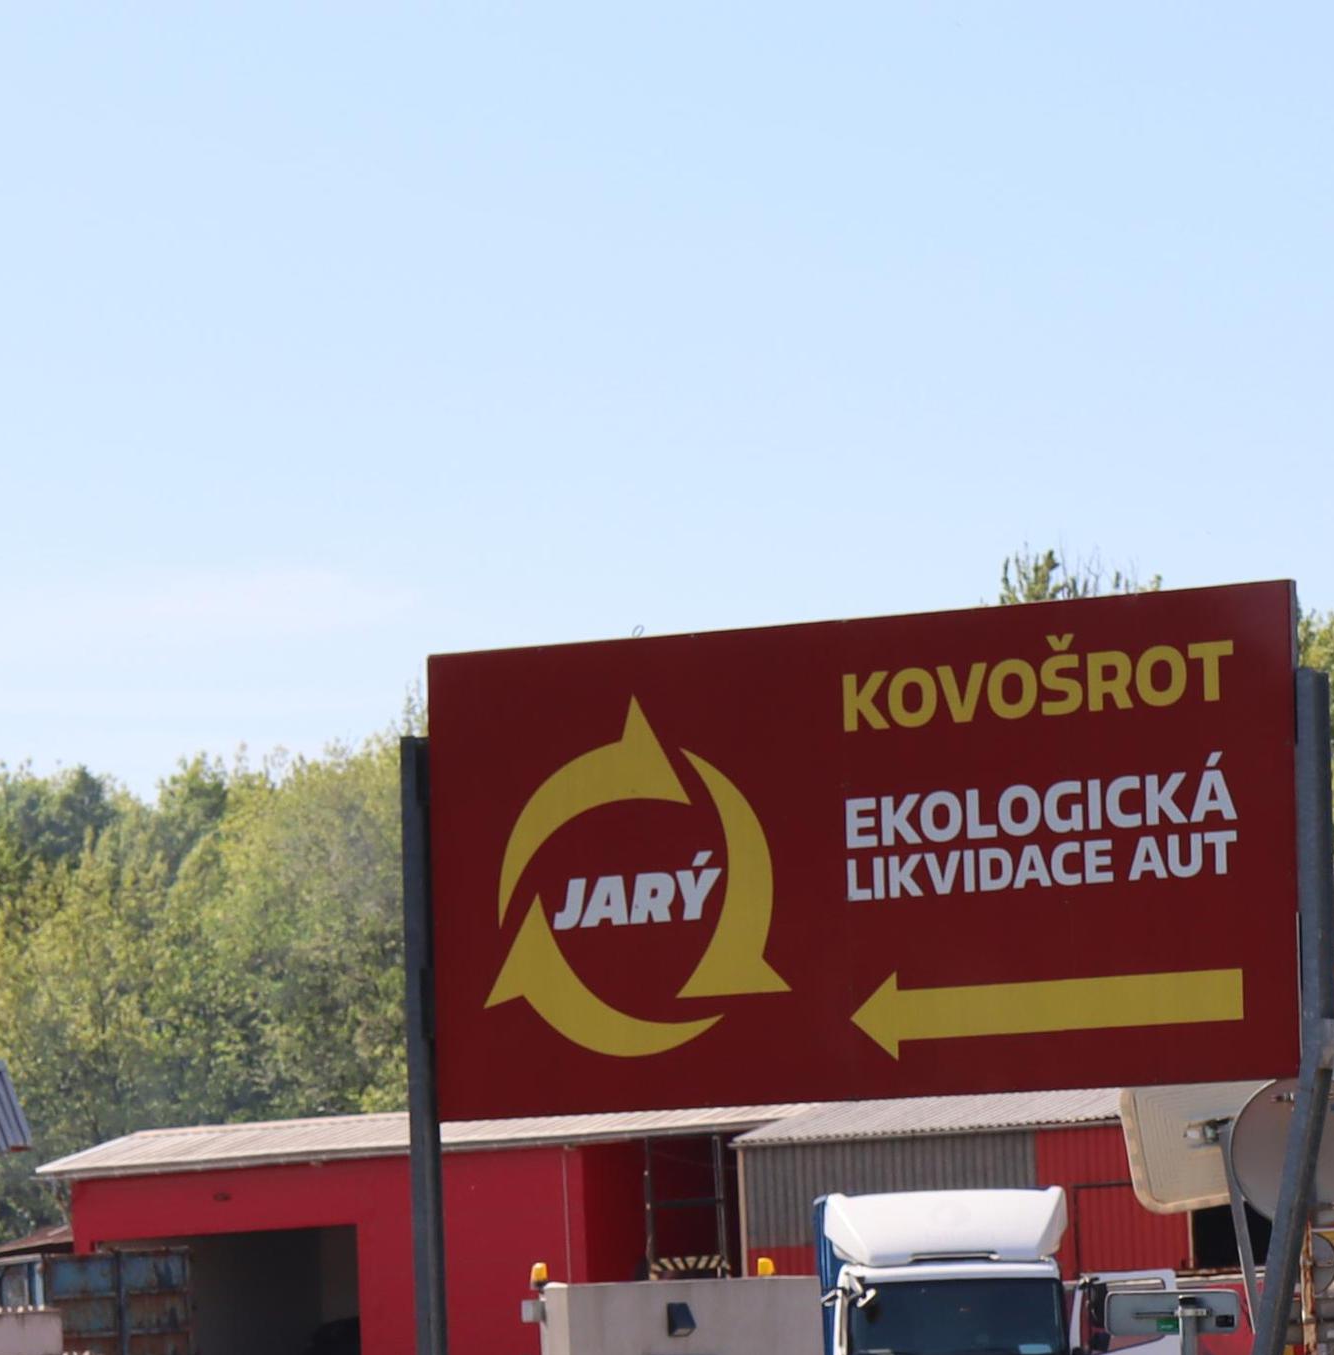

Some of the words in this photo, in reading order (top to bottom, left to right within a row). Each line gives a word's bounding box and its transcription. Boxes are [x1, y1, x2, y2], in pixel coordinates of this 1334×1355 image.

[842, 634, 1234, 732] KOVOŠROT
[845, 750, 1238, 849] EKOLOGICKÁ
[553, 850, 721, 930] JARÝ
[846, 839, 1114, 902] LIKVIDACE
[1128, 829, 1238, 881] AUT
